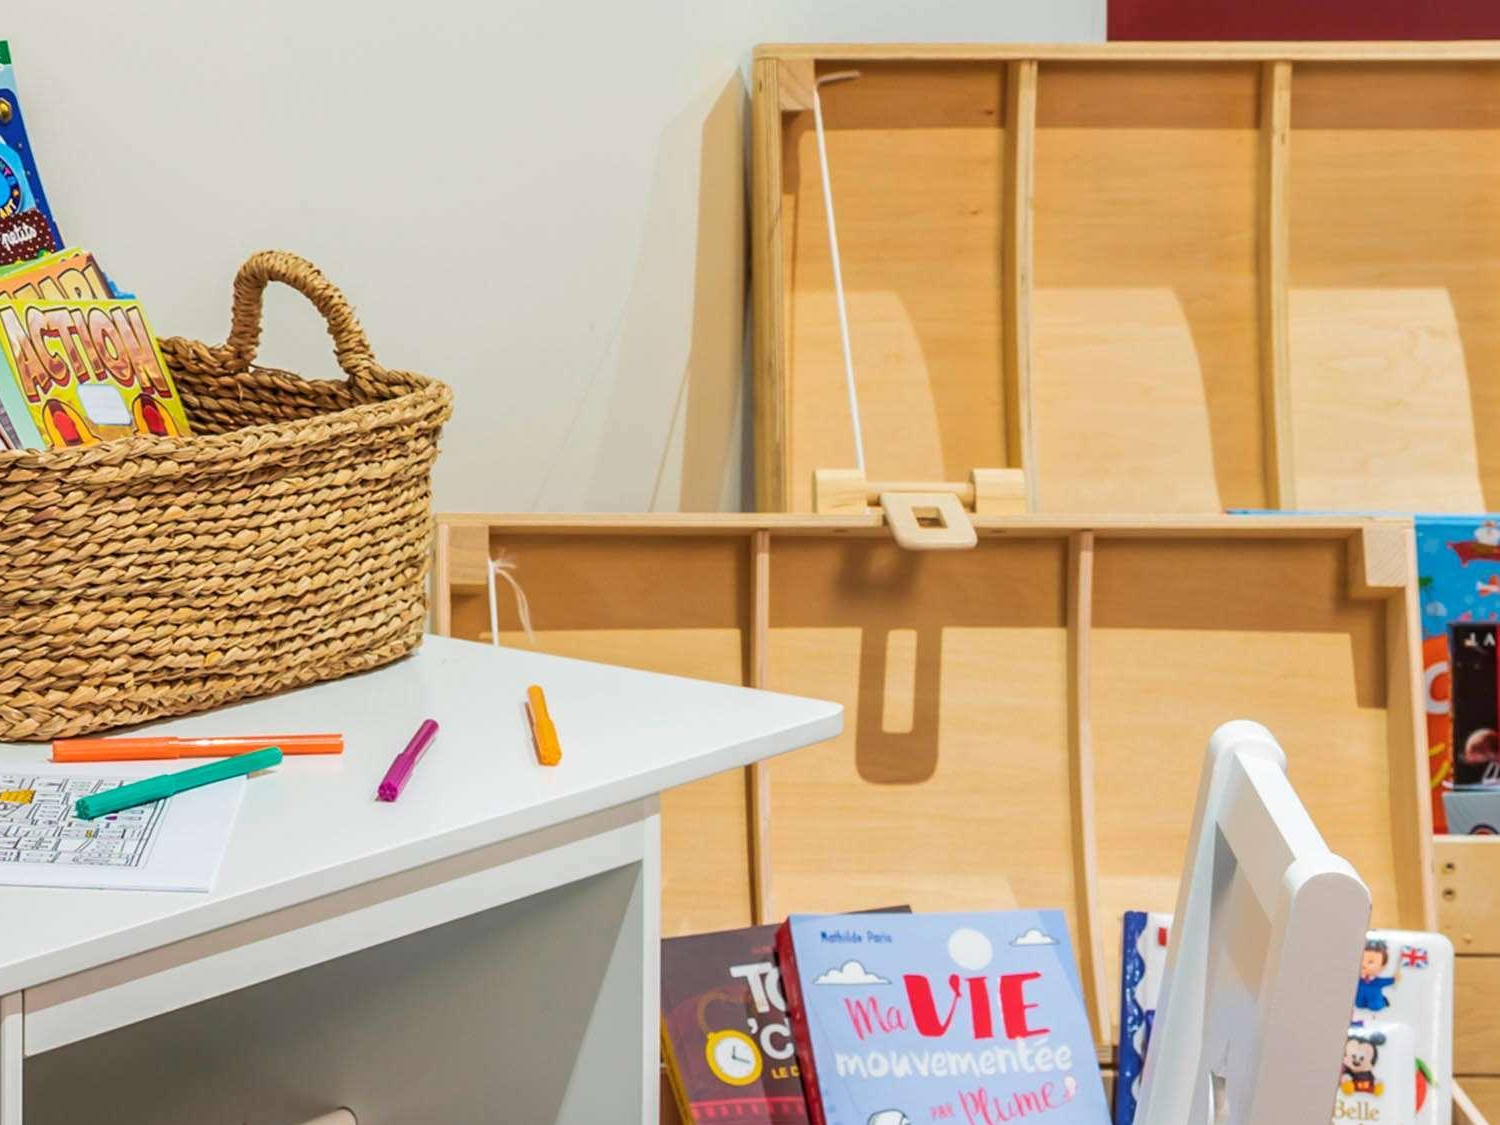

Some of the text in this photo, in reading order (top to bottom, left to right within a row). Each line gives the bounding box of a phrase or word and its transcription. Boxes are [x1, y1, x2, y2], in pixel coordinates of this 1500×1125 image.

[0, 220, 39, 248] petits
[843, 970, 1052, 1041] Ma VIE
[834, 1036, 1075, 1080] mouvementée
[1333, 1100, 1381, 1122] Belle
